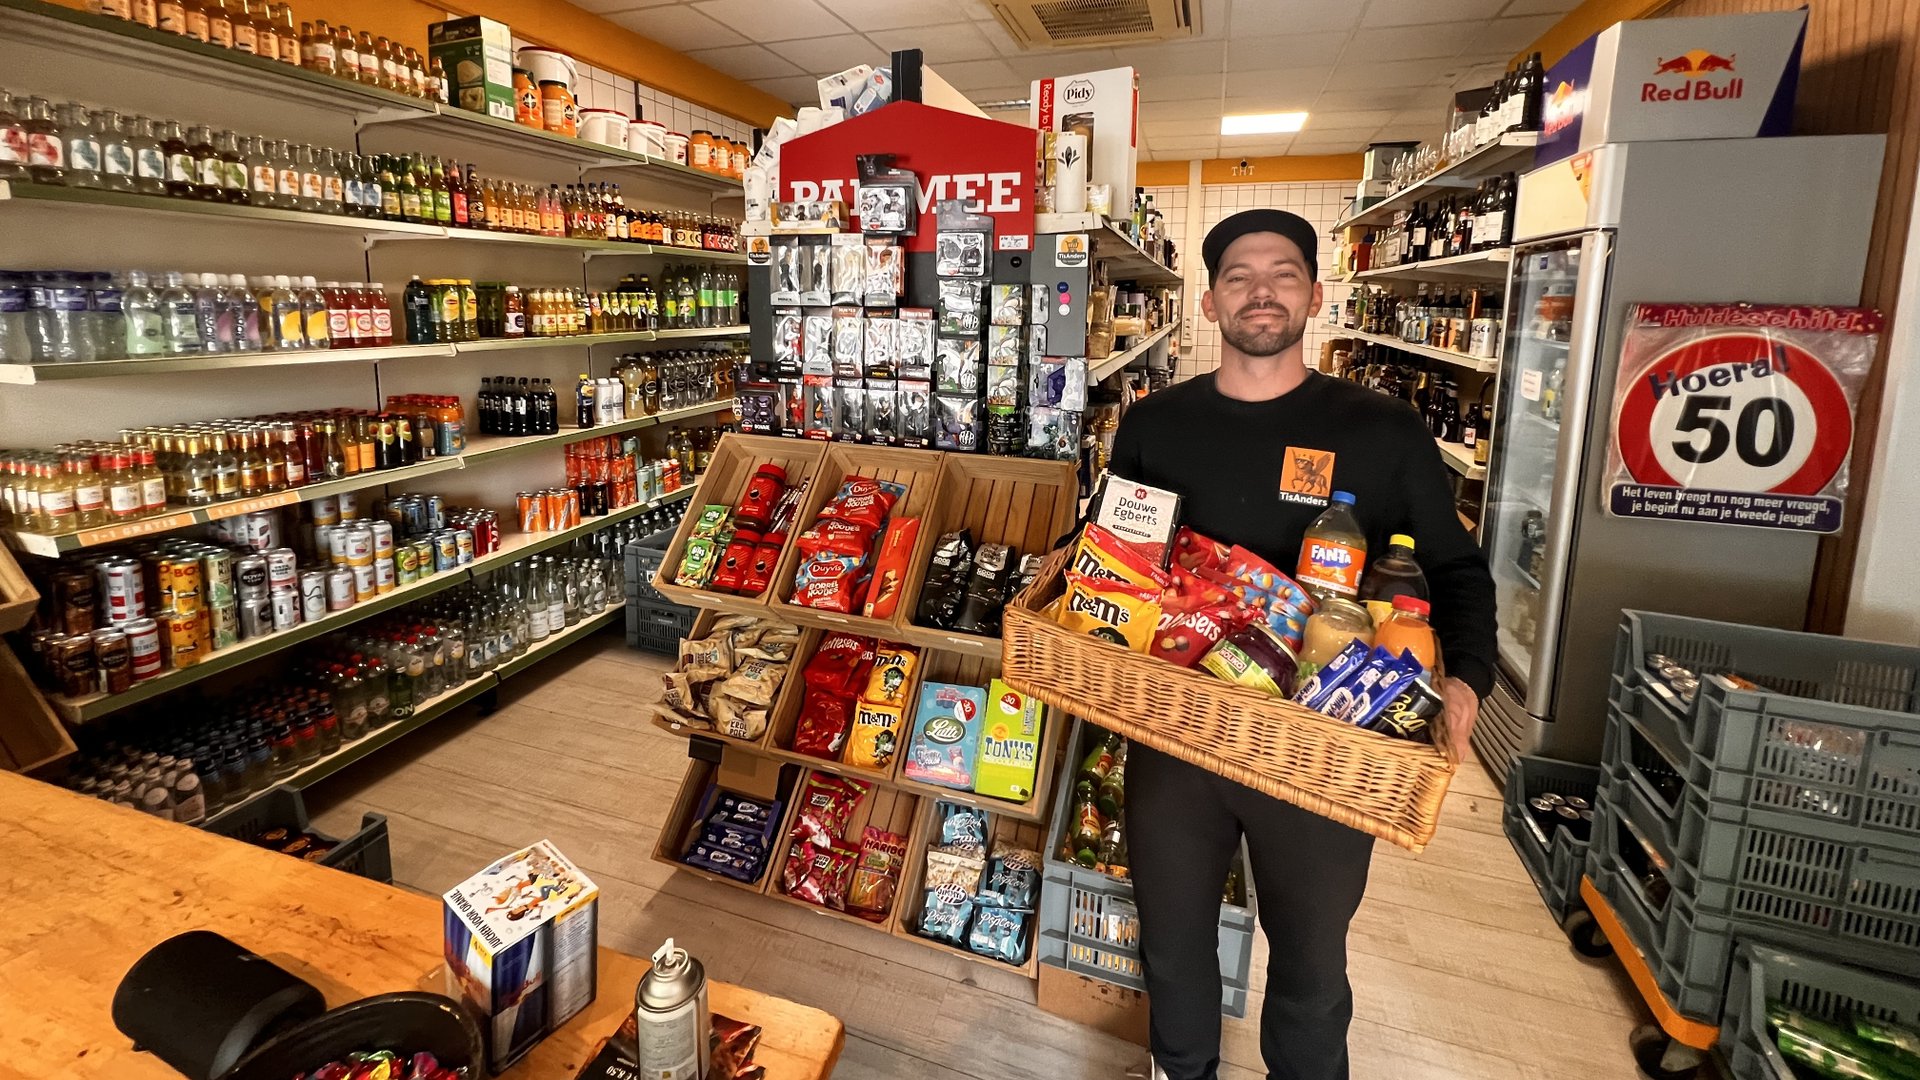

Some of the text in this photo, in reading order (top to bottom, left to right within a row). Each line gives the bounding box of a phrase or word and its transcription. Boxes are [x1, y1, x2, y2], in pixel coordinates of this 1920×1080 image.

[1040, 83, 1052, 113] Ready
[1066, 87, 1093, 100] Pidy
[1641, 77, 1744, 102] Red Bull
[790, 179, 864, 217] PA
[1058, 252, 1086, 260] TisAnders
[1663, 306, 1860, 332] Huldeschild
[1671, 395, 1795, 468] 50
[1118, 496, 1158, 514] Douwe
[1279, 491, 1329, 507] TisAnders
[1622, 485, 1831, 515] Het leven brengt nu nog meer vreugd,
[1113, 507, 1158, 526] Egberts
[1631, 500, 1642, 513] je
[1681, 505, 1695, 515] nu
[1697, 507, 1718, 517] aan
[1719, 507, 1732, 519] je
[1735, 508, 1776, 522] tweede
[1777, 510, 1816, 526] jeugd!
[122, 518, 177, 535] GRATIS
[1311, 543, 1352, 564] FANTA
[812, 564, 842, 575] Duyvis
[1150, 571, 1170, 587] FAMILY
[808, 580, 839, 592] BORREL
[926, 718, 962, 740] Lutti
[865, 839, 907, 857] HARIBO
[989, 871, 1031, 891] Popcorn
[450, 888, 503, 949] JUICHEN VOOR ORANJE
[924, 908, 965, 928] Popcorn
[980, 911, 1021, 933] Popcorn
[606, 1065, 625, 1079] 8,50
